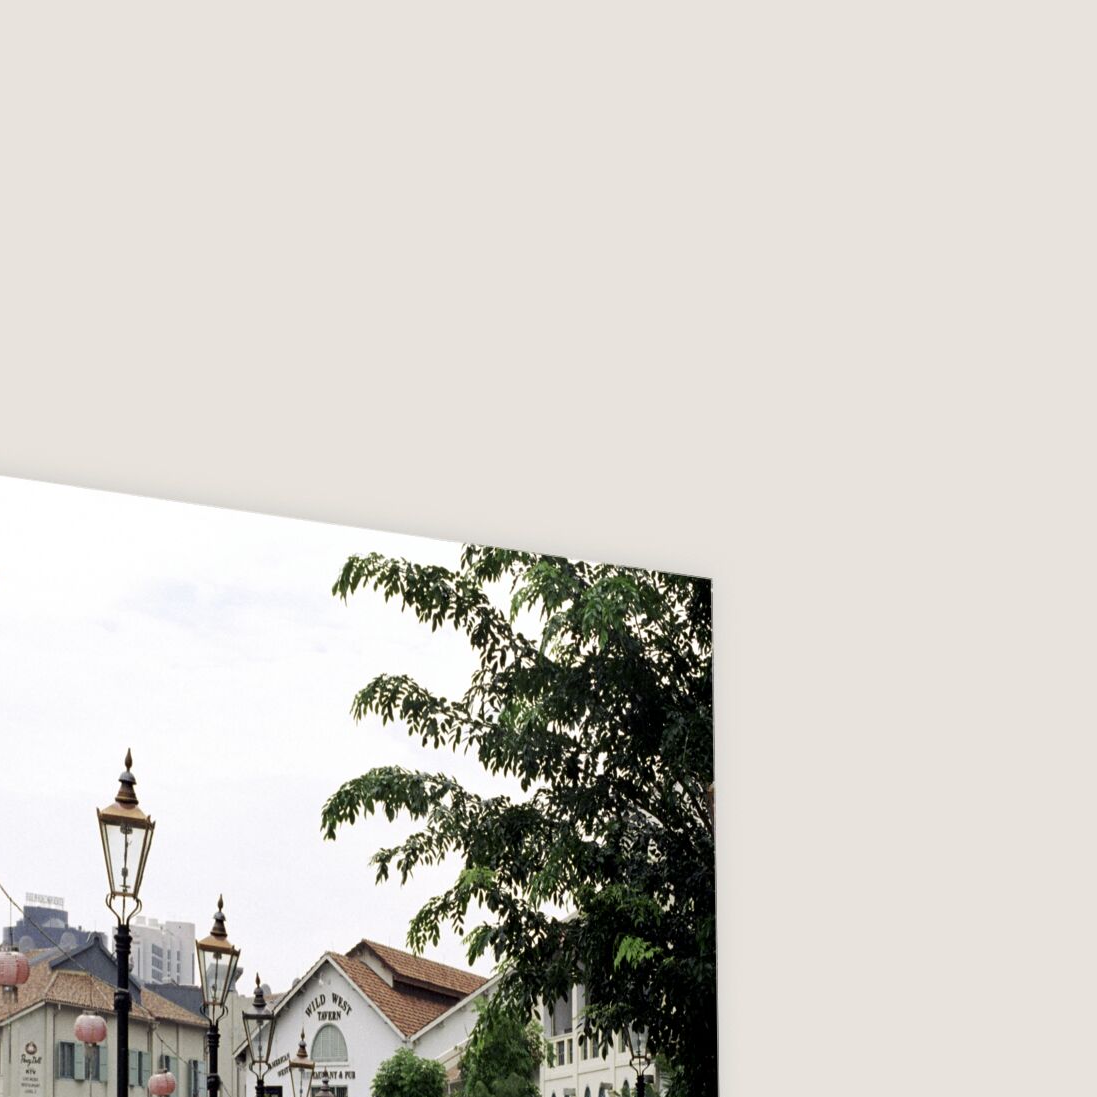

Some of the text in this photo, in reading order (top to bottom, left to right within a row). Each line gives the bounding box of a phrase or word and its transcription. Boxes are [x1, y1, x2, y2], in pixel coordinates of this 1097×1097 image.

[305, 992, 352, 1018] WILD WEST
[317, 1010, 341, 1021] TAVERN
[344, 1070, 356, 1080] PUB
